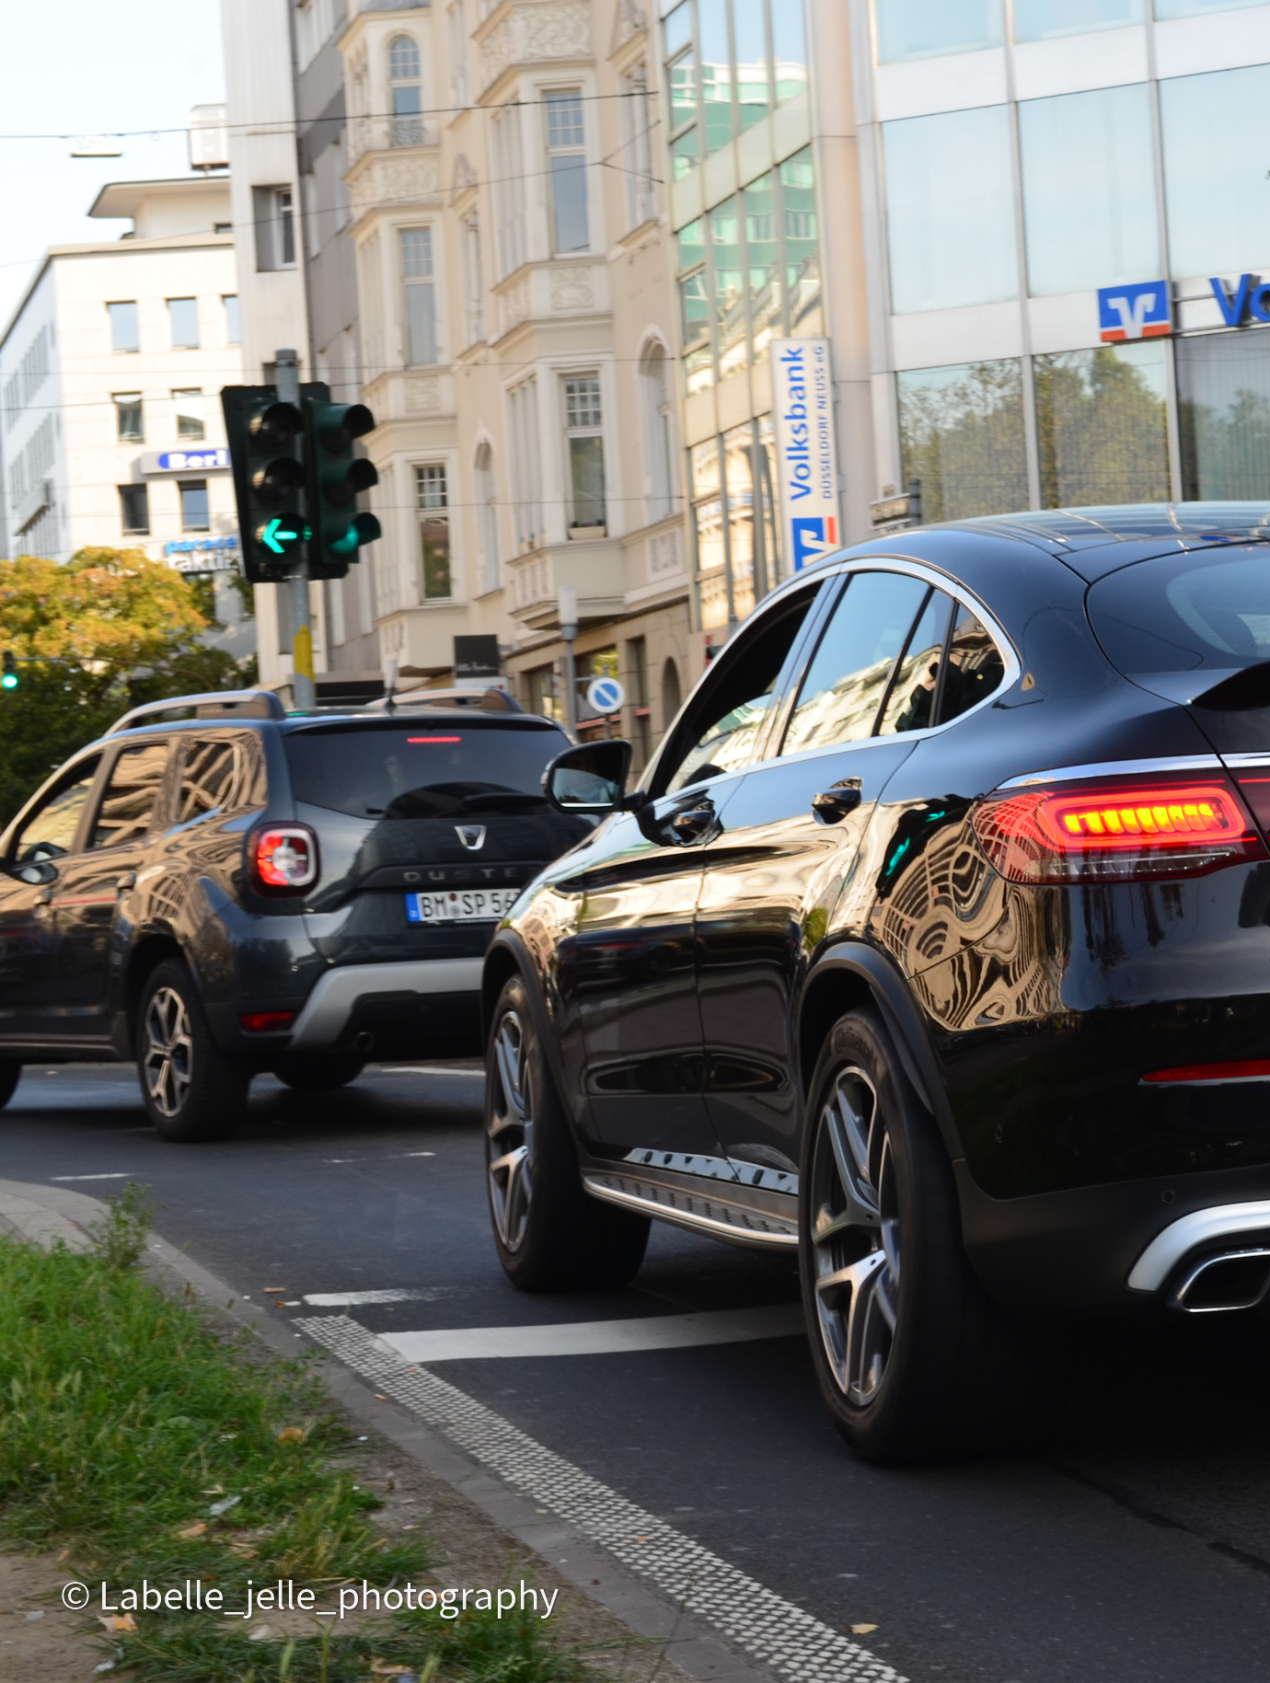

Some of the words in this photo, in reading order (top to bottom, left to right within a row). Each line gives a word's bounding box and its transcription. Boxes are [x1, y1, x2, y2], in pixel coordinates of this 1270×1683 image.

[814, 367, 828, 409] NEUSS
[780, 347, 812, 500] Volksbank
[818, 415, 833, 499] DÜSSELDORF
[421, 895, 448, 918] BM
[462, 893, 486, 915] SP
